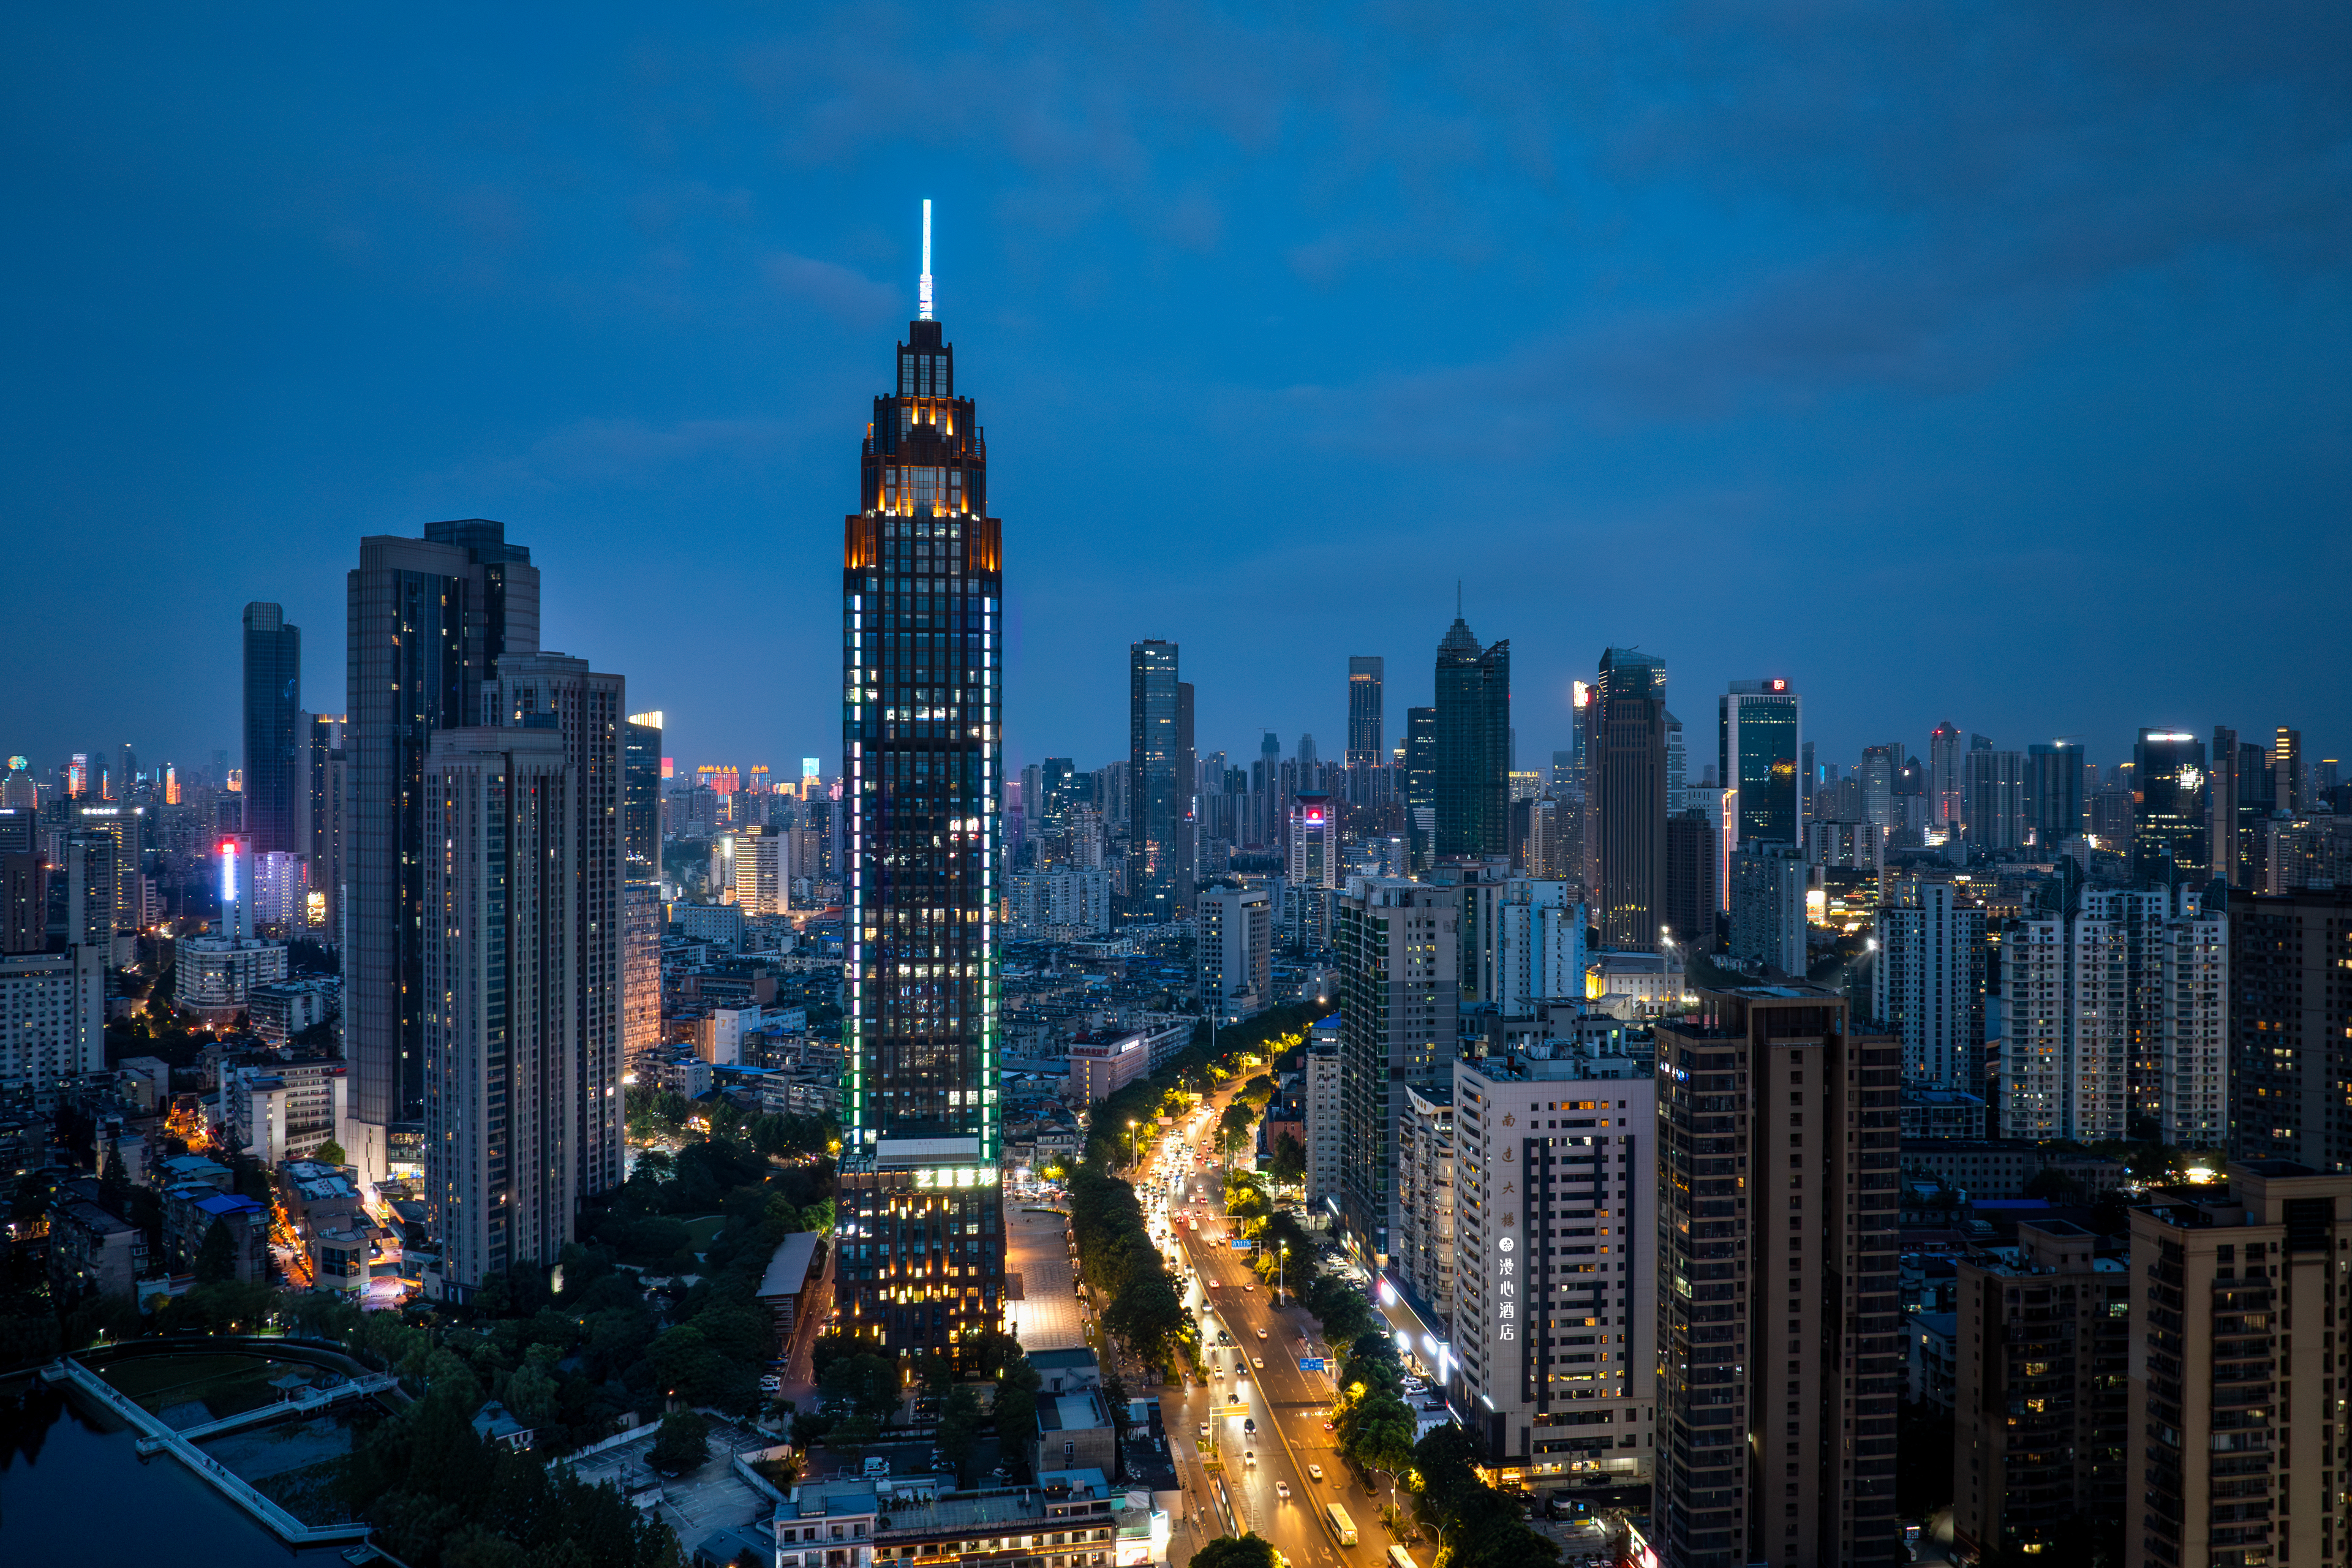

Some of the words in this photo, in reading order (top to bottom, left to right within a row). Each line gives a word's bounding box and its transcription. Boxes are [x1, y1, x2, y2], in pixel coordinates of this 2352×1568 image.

[915, 1167, 997, 1188] 艺形
[1499, 1258, 1514, 1340] 漫心酒店
